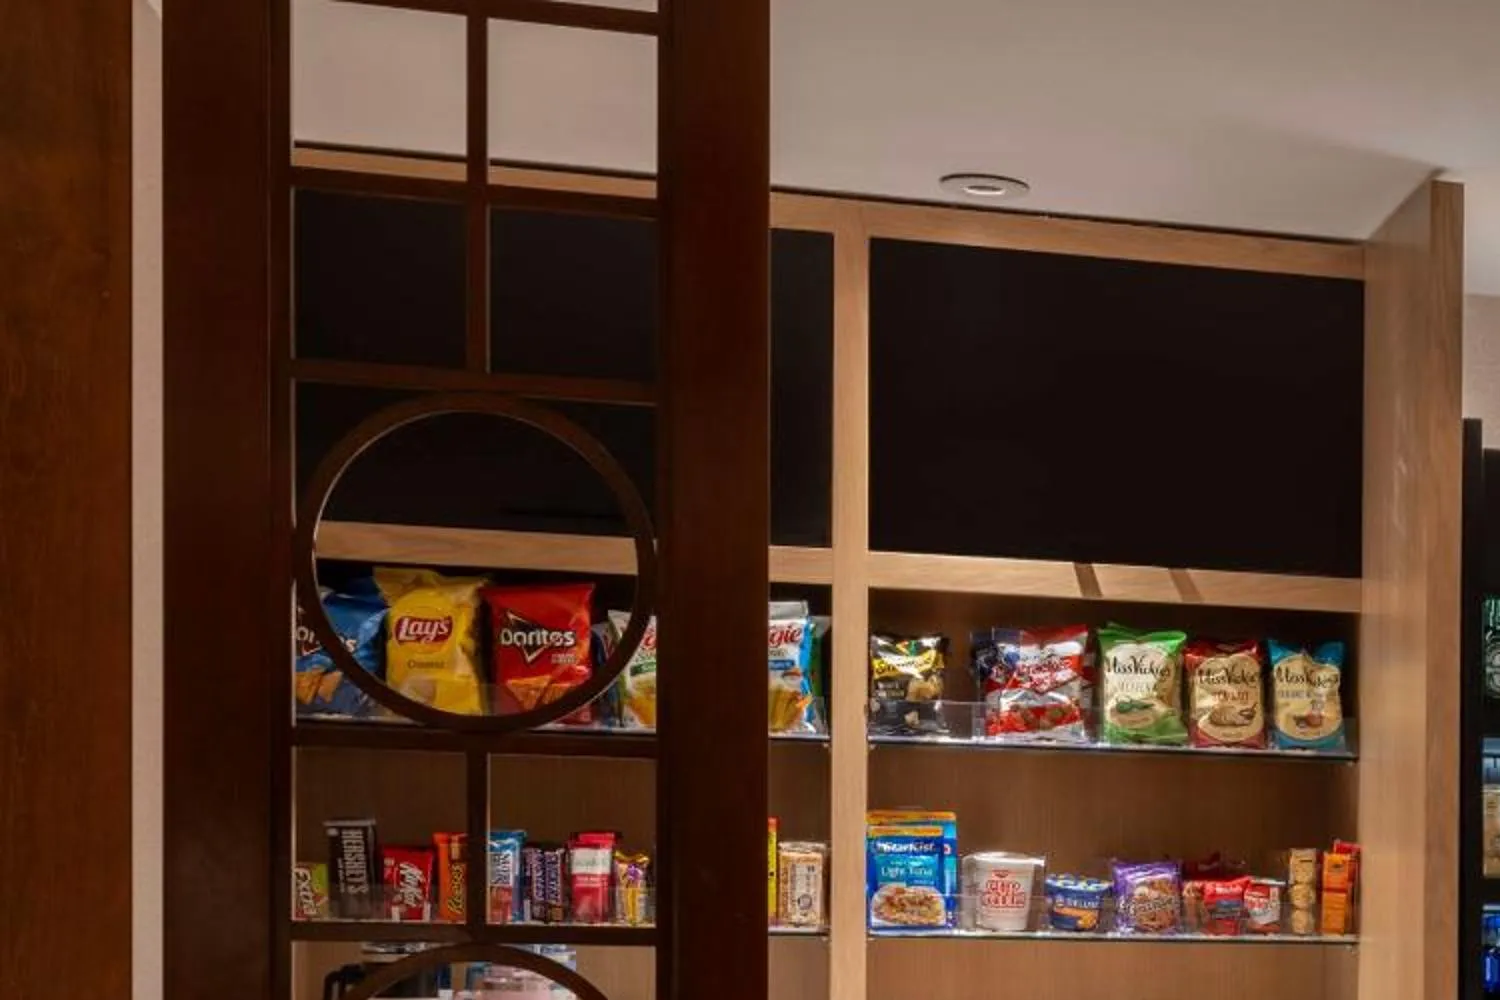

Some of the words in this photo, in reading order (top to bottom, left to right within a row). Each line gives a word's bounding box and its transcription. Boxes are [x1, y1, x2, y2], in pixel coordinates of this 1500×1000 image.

[400, 616, 450, 643] Lay's
[500, 628, 576, 647] Doritos
[342, 829, 369, 894] HERSHEY'S
